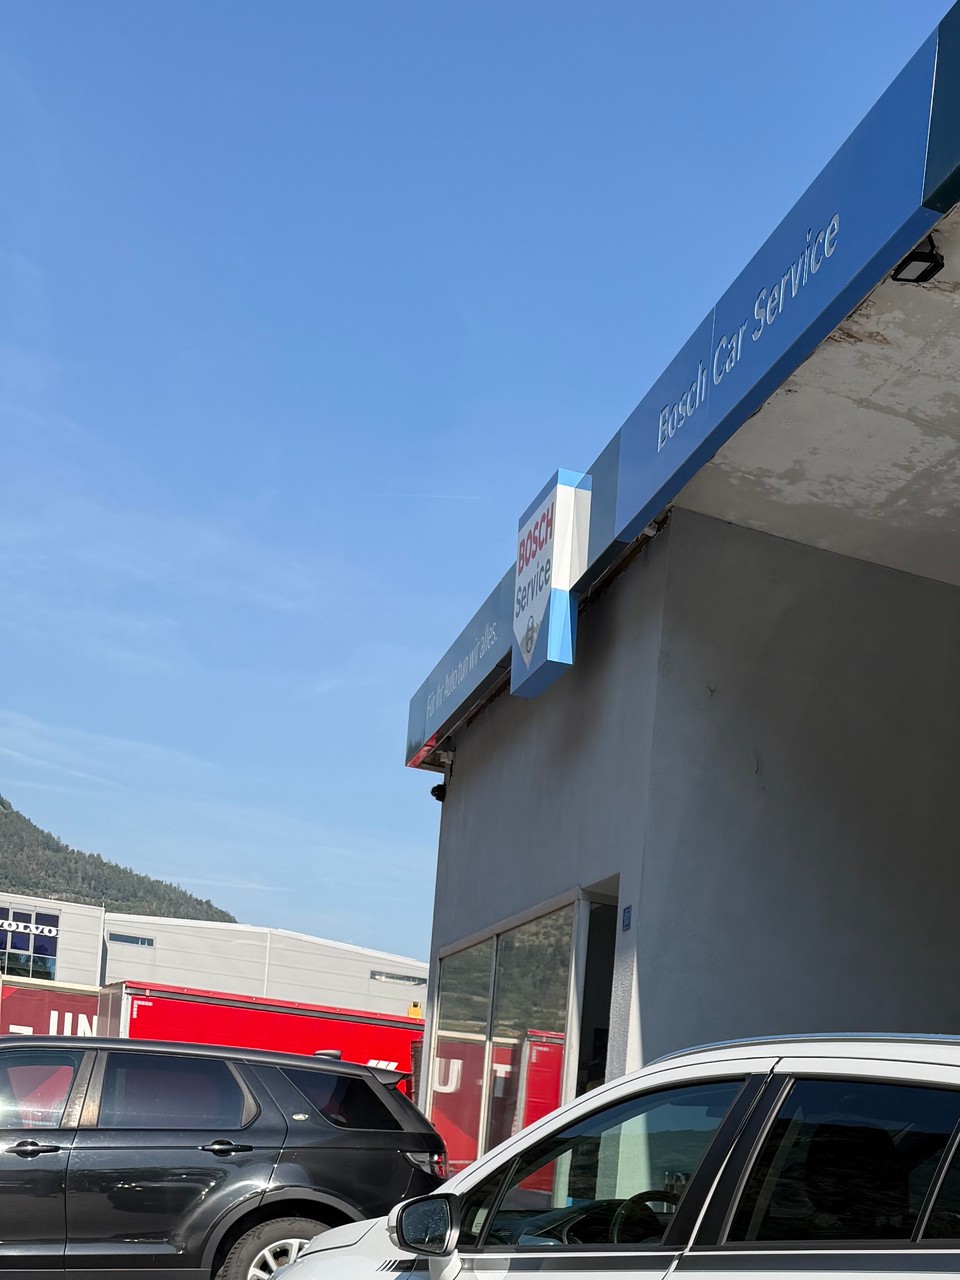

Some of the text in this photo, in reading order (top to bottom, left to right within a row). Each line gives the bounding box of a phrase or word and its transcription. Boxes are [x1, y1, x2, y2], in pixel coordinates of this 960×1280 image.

[657, 211, 840, 453] Bosch Car Service
[518, 502, 554, 577] BOSCH
[515, 557, 551, 619] Service
